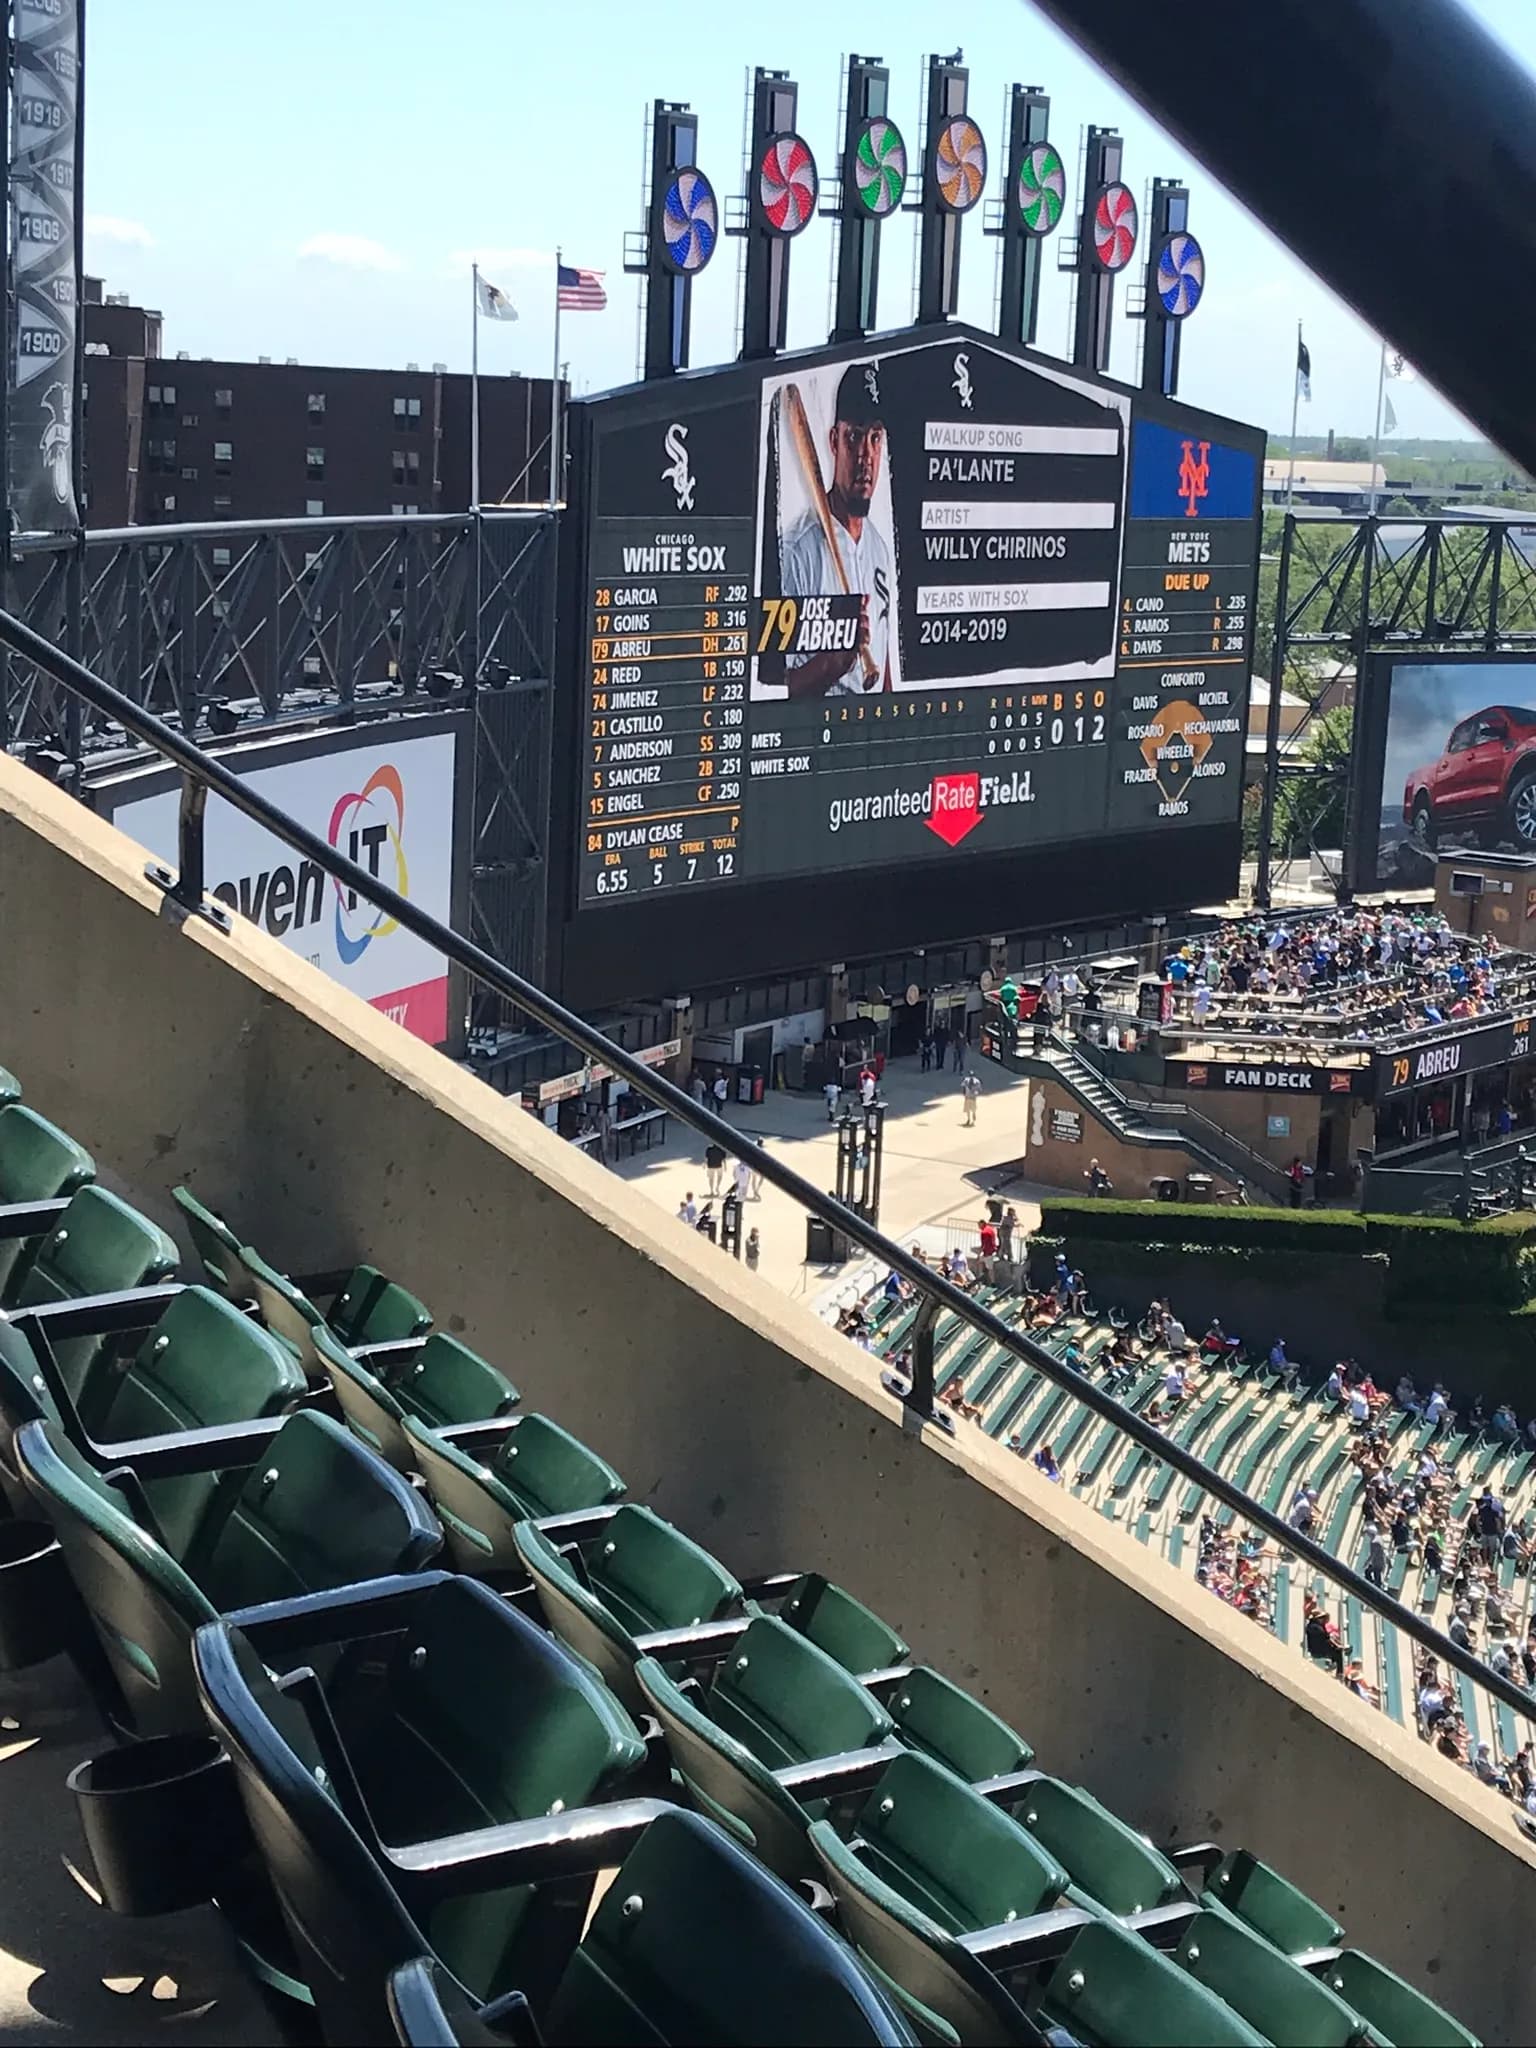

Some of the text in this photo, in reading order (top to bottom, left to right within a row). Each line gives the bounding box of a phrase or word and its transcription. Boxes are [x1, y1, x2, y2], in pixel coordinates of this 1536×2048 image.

[23, 101, 61, 127] 1919
[23, 332, 61, 353] 1900
[929, 428, 1023, 447] WALKUP SONG
[928, 457, 1015, 482] PA'LANTE
[925, 508, 971, 525] ARTIST
[655, 534, 695, 545] CHICAGO
[925, 536, 1066, 560] WILLY CHIRINOS
[1190, 532, 1210, 541] YORK
[623, 546, 726, 573] WHITE SOX
[1168, 542, 1210, 563] METS
[1165, 573, 1210, 591] DUE UP
[595, 585, 748, 607] 28 GARCIA RF .292
[923, 589, 1029, 609] YEARS WITH SOX
[1136, 598, 1164, 612] CANO
[1216, 596, 1221, 610] L
[1227, 595, 1246, 609] .235
[596, 610, 746, 632] 17 GOINS 3B .316
[757, 598, 831, 652] 79 JOSE
[919, 617, 1008, 644] 2014-2019
[1134, 618, 1169, 633] RAMOS
[1214, 617, 1221, 631] R
[1225, 616, 1245, 629] .255
[796, 618, 858, 651] ABREU
[1133, 640, 1162, 655] DAVIS
[1212, 637, 1220, 651] R
[595, 636, 746, 659] 79 ABREU DH .261
[593, 660, 745, 685] 24 REED 1B .150
[1161, 672, 1206, 688] CONFORTO
[592, 684, 744, 711] 74 JIMENEZ LF .232
[825, 709, 831, 722] 1
[841, 708, 848, 720] 2
[858, 707, 864, 719] 3
[875, 706, 882, 718] 4
[893, 704, 899, 717] 5
[909, 703, 916, 716] 6
[926, 702, 932, 714] 7
[957, 699, 964, 712] 9
[989, 697, 998, 709] R
[1021, 695, 1028, 707] E
[1053, 690, 1105, 711] B S O
[1133, 696, 1158, 710] DAVIS
[592, 708, 743, 737] 21 CASTILLO C .180
[751, 712, 1043, 749] METS 0 0 0 0 5
[1051, 715, 1105, 744] 0 1 2
[1128, 724, 1164, 740] ROSARIO
[594, 733, 742, 763] 7 ANDERSON SS .309
[751, 736, 1041, 775] WHITE SOX 0 0 0 5
[1157, 744, 1194, 760] WHEELER
[593, 758, 741, 789] 5 SANCHEZ 2B .251
[1124, 768, 1158, 784] FRAZIER
[1192, 762, 1226, 778] ALONSO
[590, 783, 739, 815] 15 ENGEL CF .250
[829, 783, 932, 832] guaranteed
[934, 782, 975, 811] Rate
[1159, 801, 1189, 817] RAMOS
[587, 816, 739, 851] 84 DYLAN CEASE P
[605, 837, 736, 865] ERA BALL STRIKE TOTAL
[597, 853, 734, 894] 6.55 5 7 12
[1392, 1044, 1461, 1087] 79 ABREU
[1225, 1069, 1261, 1086] FAN
[1264, 1072, 1312, 1088] DECK
